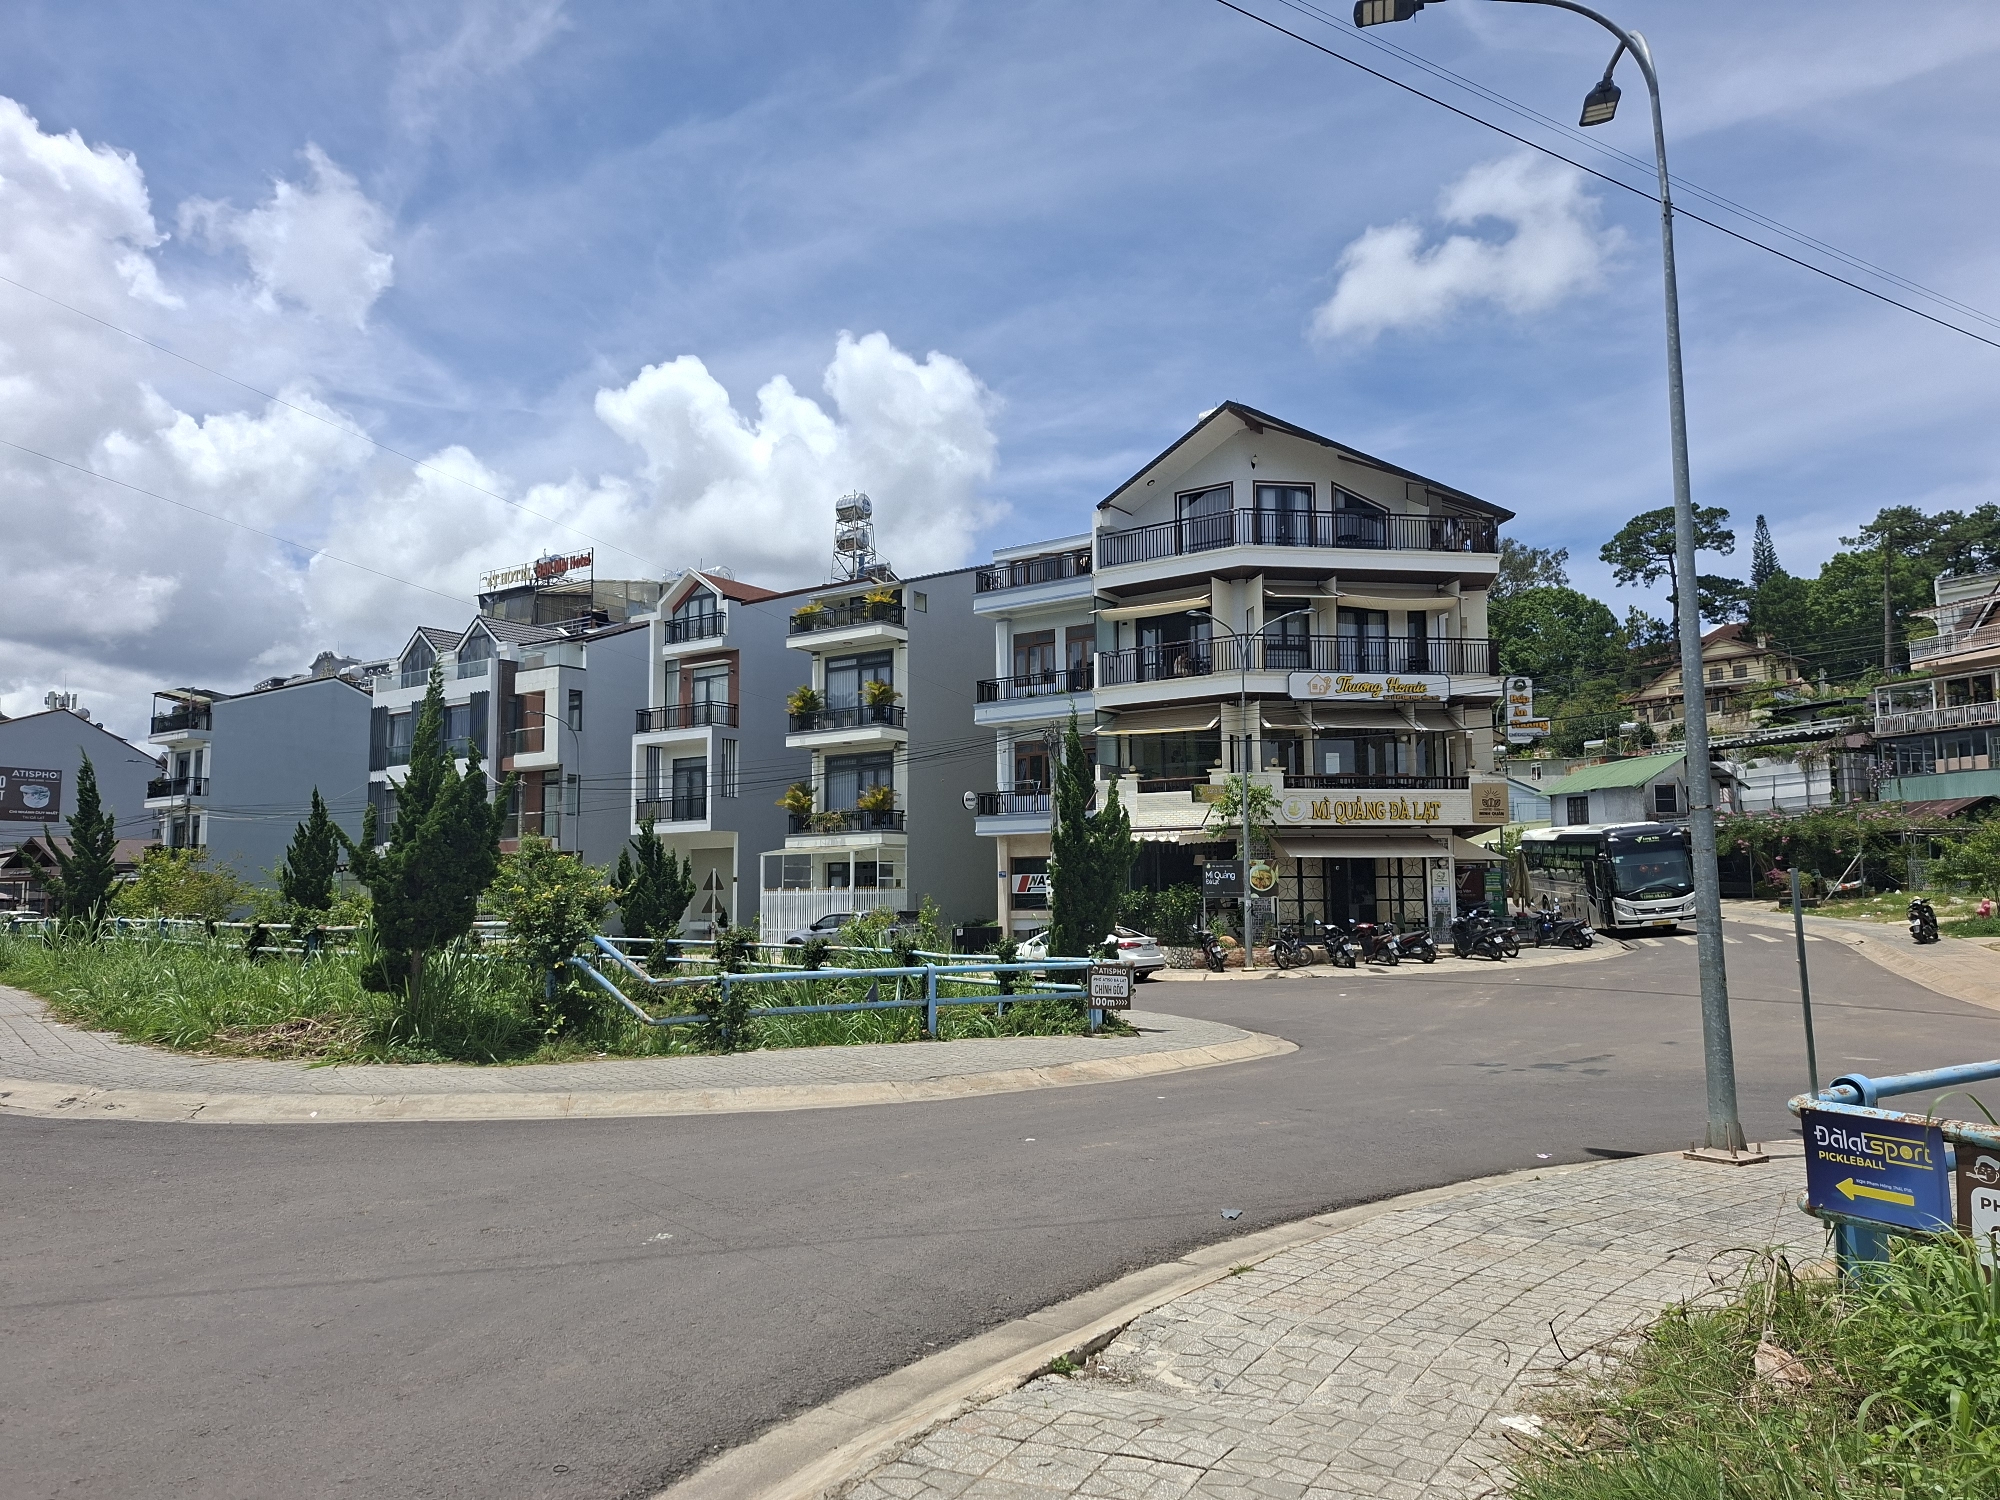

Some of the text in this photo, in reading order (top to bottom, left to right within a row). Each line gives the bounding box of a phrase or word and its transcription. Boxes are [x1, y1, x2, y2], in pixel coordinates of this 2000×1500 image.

[570, 552, 592, 569] Hotel
[500, 567, 532, 585] HOTEL
[1385, 676, 1427, 693] Homie
[12, 770, 57, 778] ATISPHO
[1312, 796, 1331, 820] MÌ
[1334, 795, 1387, 825] QUẢNG
[1389, 796, 1411, 820] ĐÀ
[1413, 801, 1441, 824] LẠT
[1214, 869, 1236, 881] Quảng
[1113, 983, 1123, 995] GỐC
[1818, 1150, 1886, 1171] PICKLEBALL
